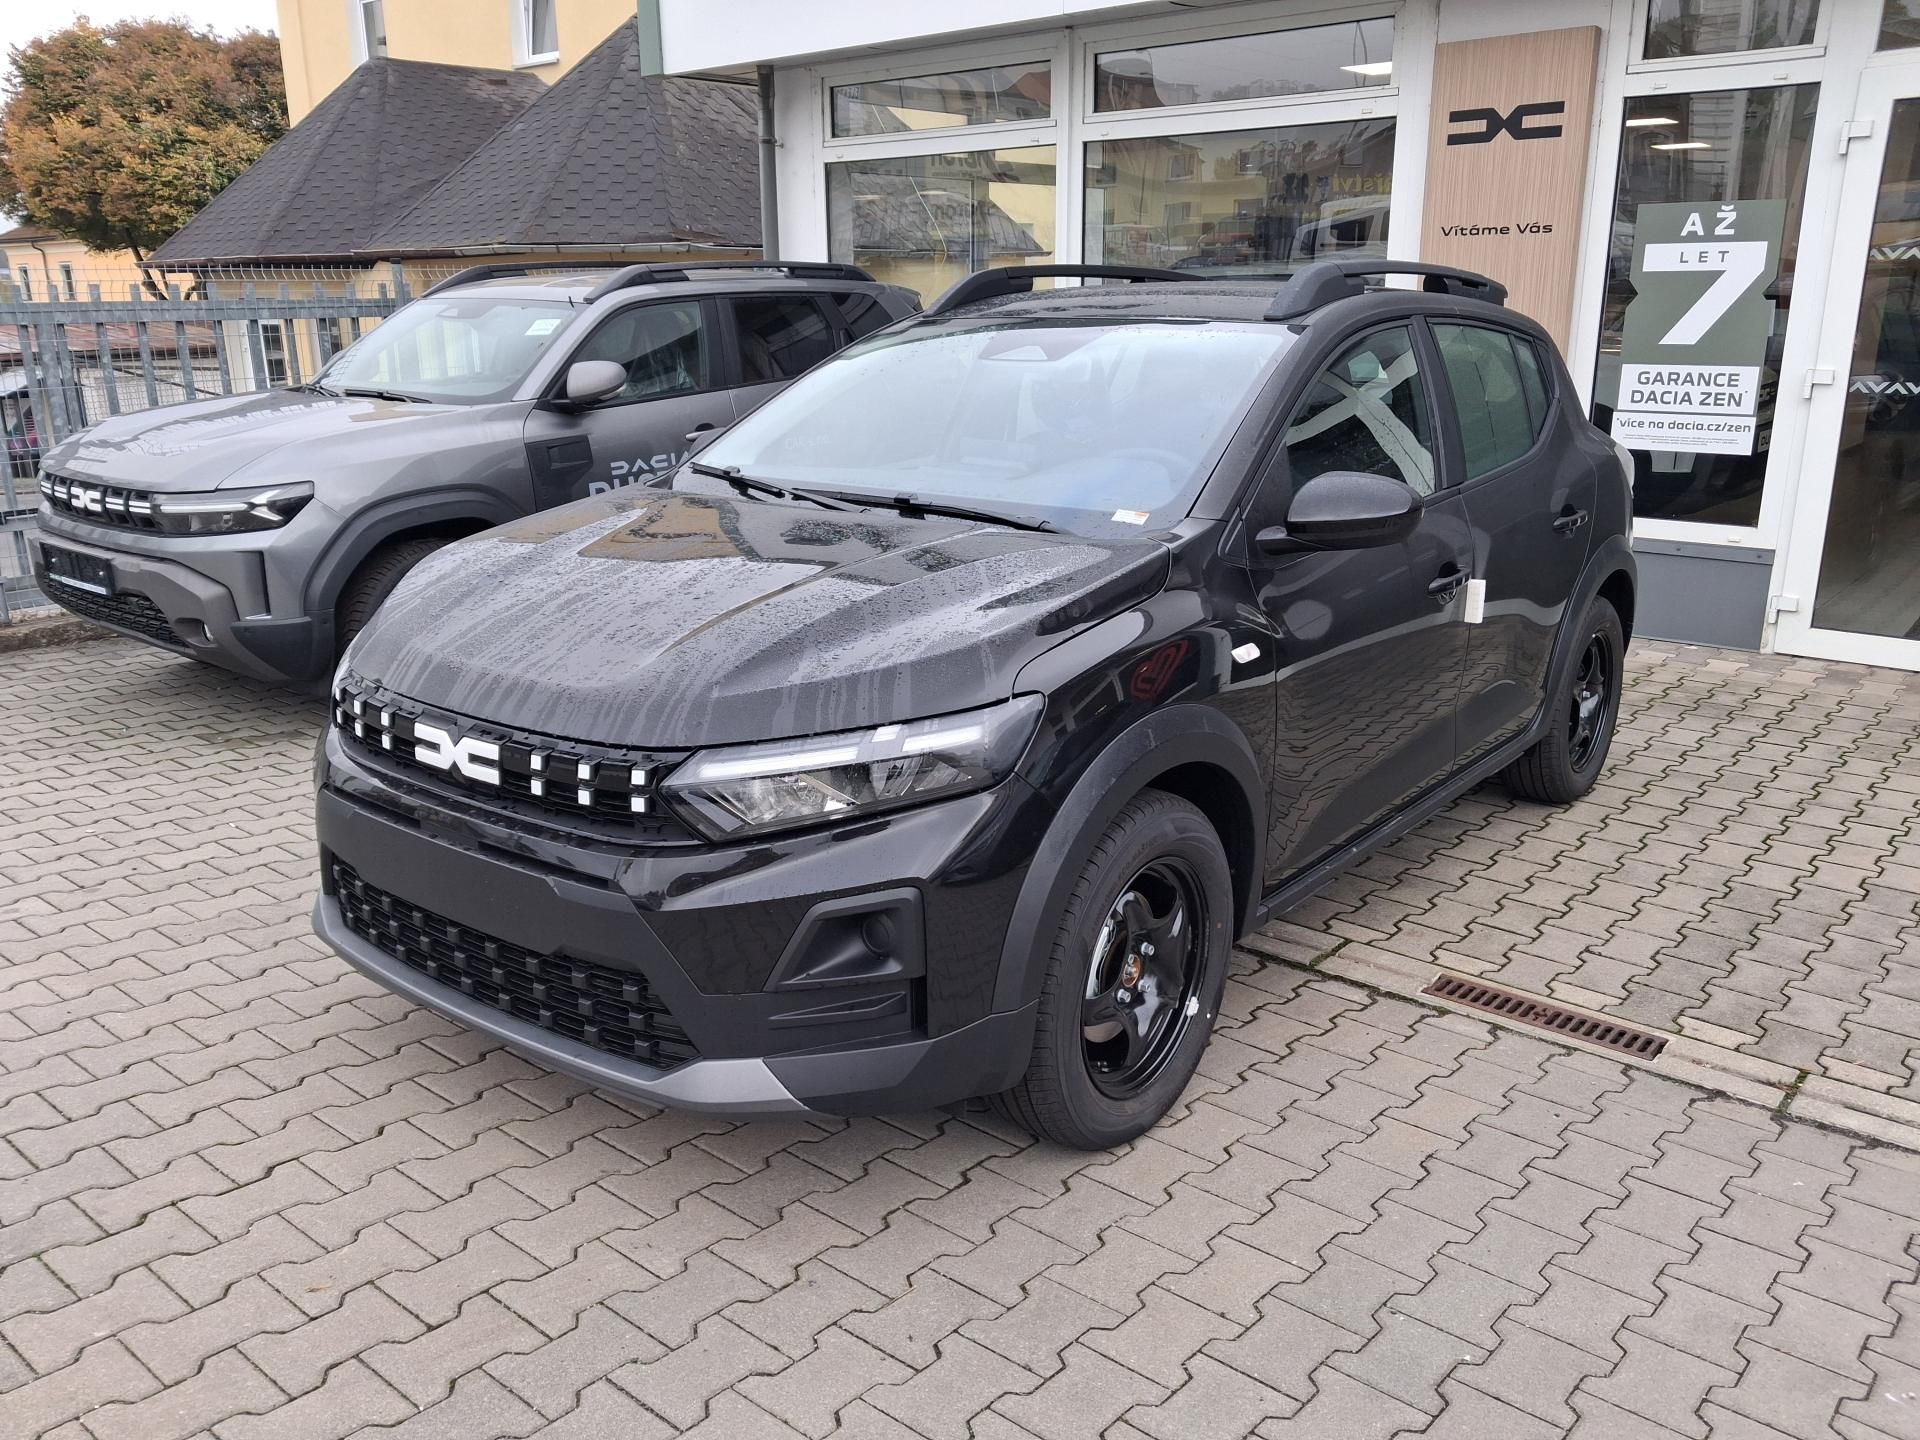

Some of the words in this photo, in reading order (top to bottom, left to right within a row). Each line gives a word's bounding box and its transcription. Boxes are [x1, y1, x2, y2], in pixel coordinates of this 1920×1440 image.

[1680, 204, 1737, 236] AŽ
[1441, 224, 1510, 237] Vítáme
[1516, 222, 1553, 234] Vás
[1679, 250, 1730, 264] LET
[1642, 241, 1769, 345] 7
[1637, 371, 1741, 388] GARANCE
[1630, 389, 1692, 406] DACIA
[1648, 421, 1665, 430] na
[1667, 419, 1751, 433] dacia.cz/zen
